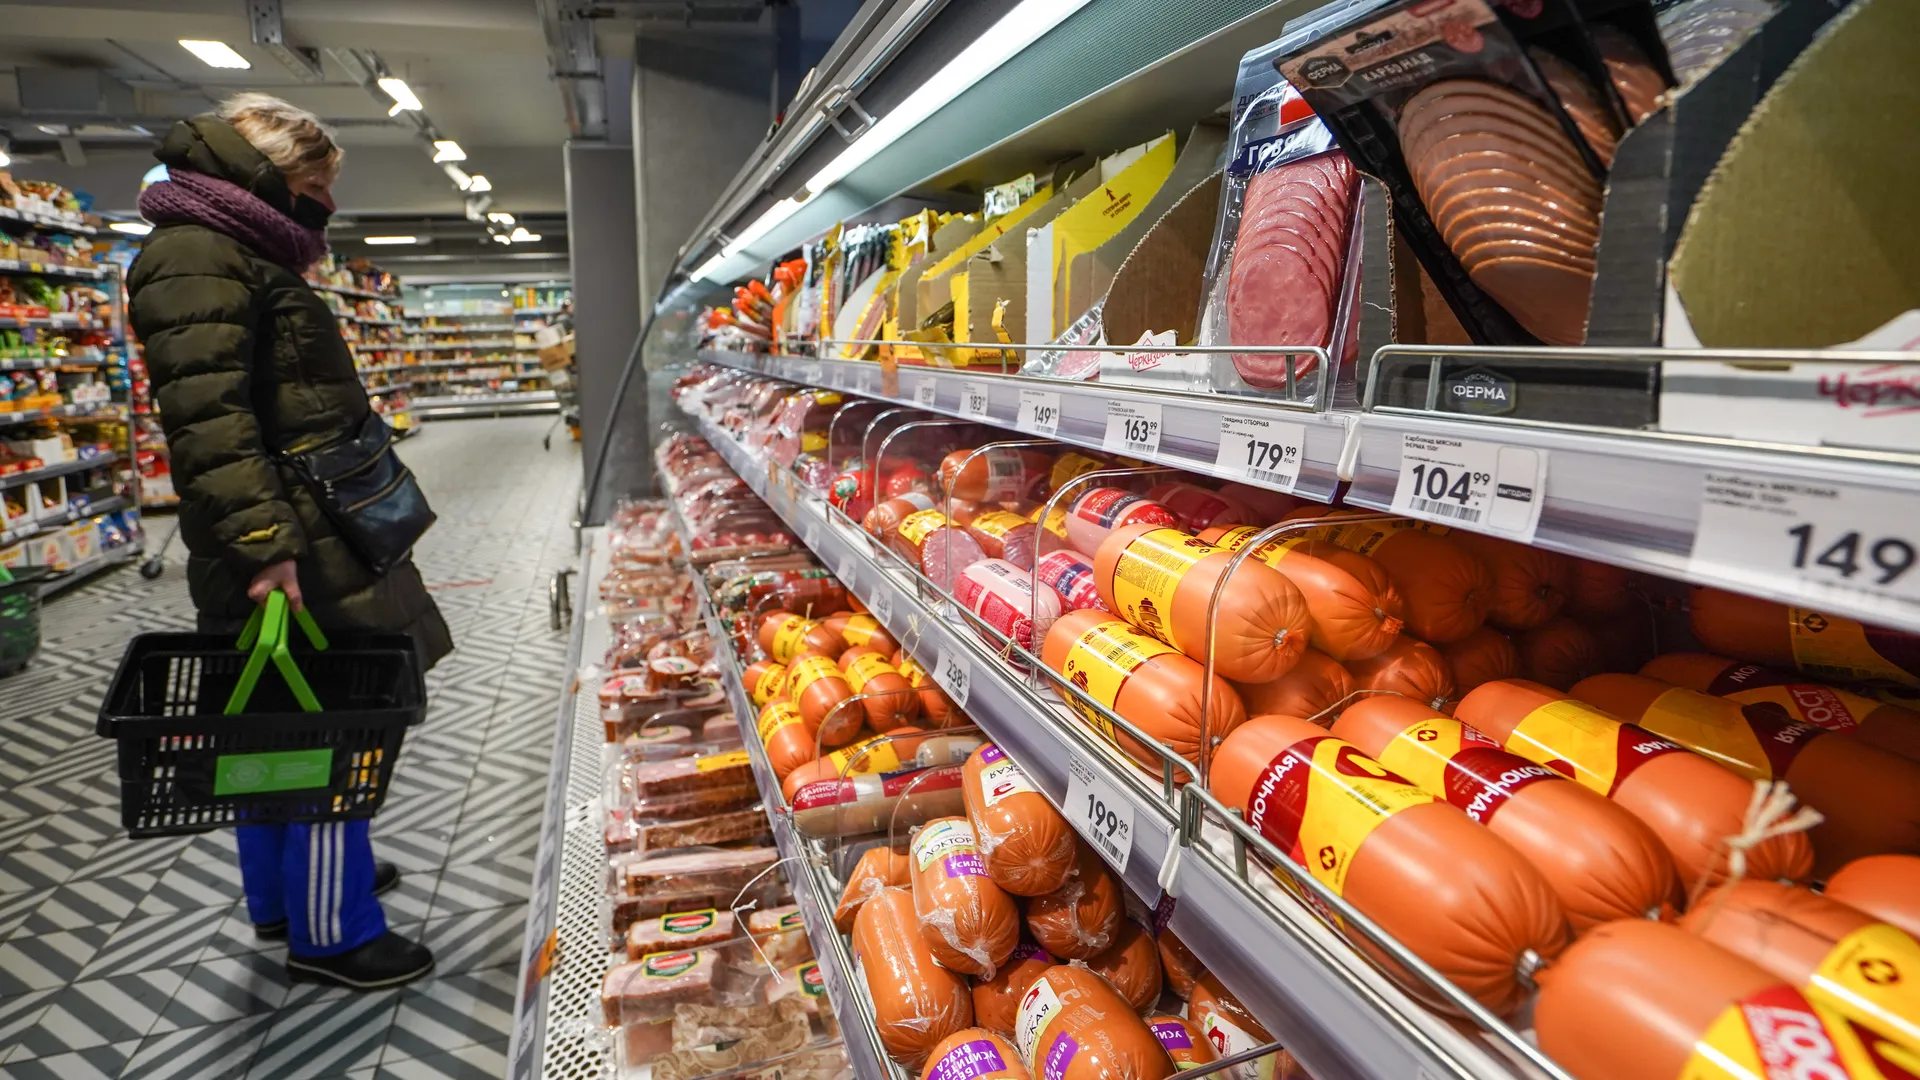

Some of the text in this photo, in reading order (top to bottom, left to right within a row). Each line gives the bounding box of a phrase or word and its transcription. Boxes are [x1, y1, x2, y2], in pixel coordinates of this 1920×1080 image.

[1307, 61, 1343, 80] ФЕРМА
[1452, 385, 1506, 400] ФЕРМА
[1034, 405, 1051, 424] 149
[1243, 418, 1270, 428] ОТБОРНАЯ
[1125, 418, 1158, 442] 163 99
[1247, 439, 1297, 470] 179 99
[1412, 464, 1491, 505] 104 99
[1787, 522, 1918, 585] 149
[946, 658, 963, 688] 238
[1088, 794, 1129, 838] 199 99
[936, 1043, 972, 1073] ВКУСА
